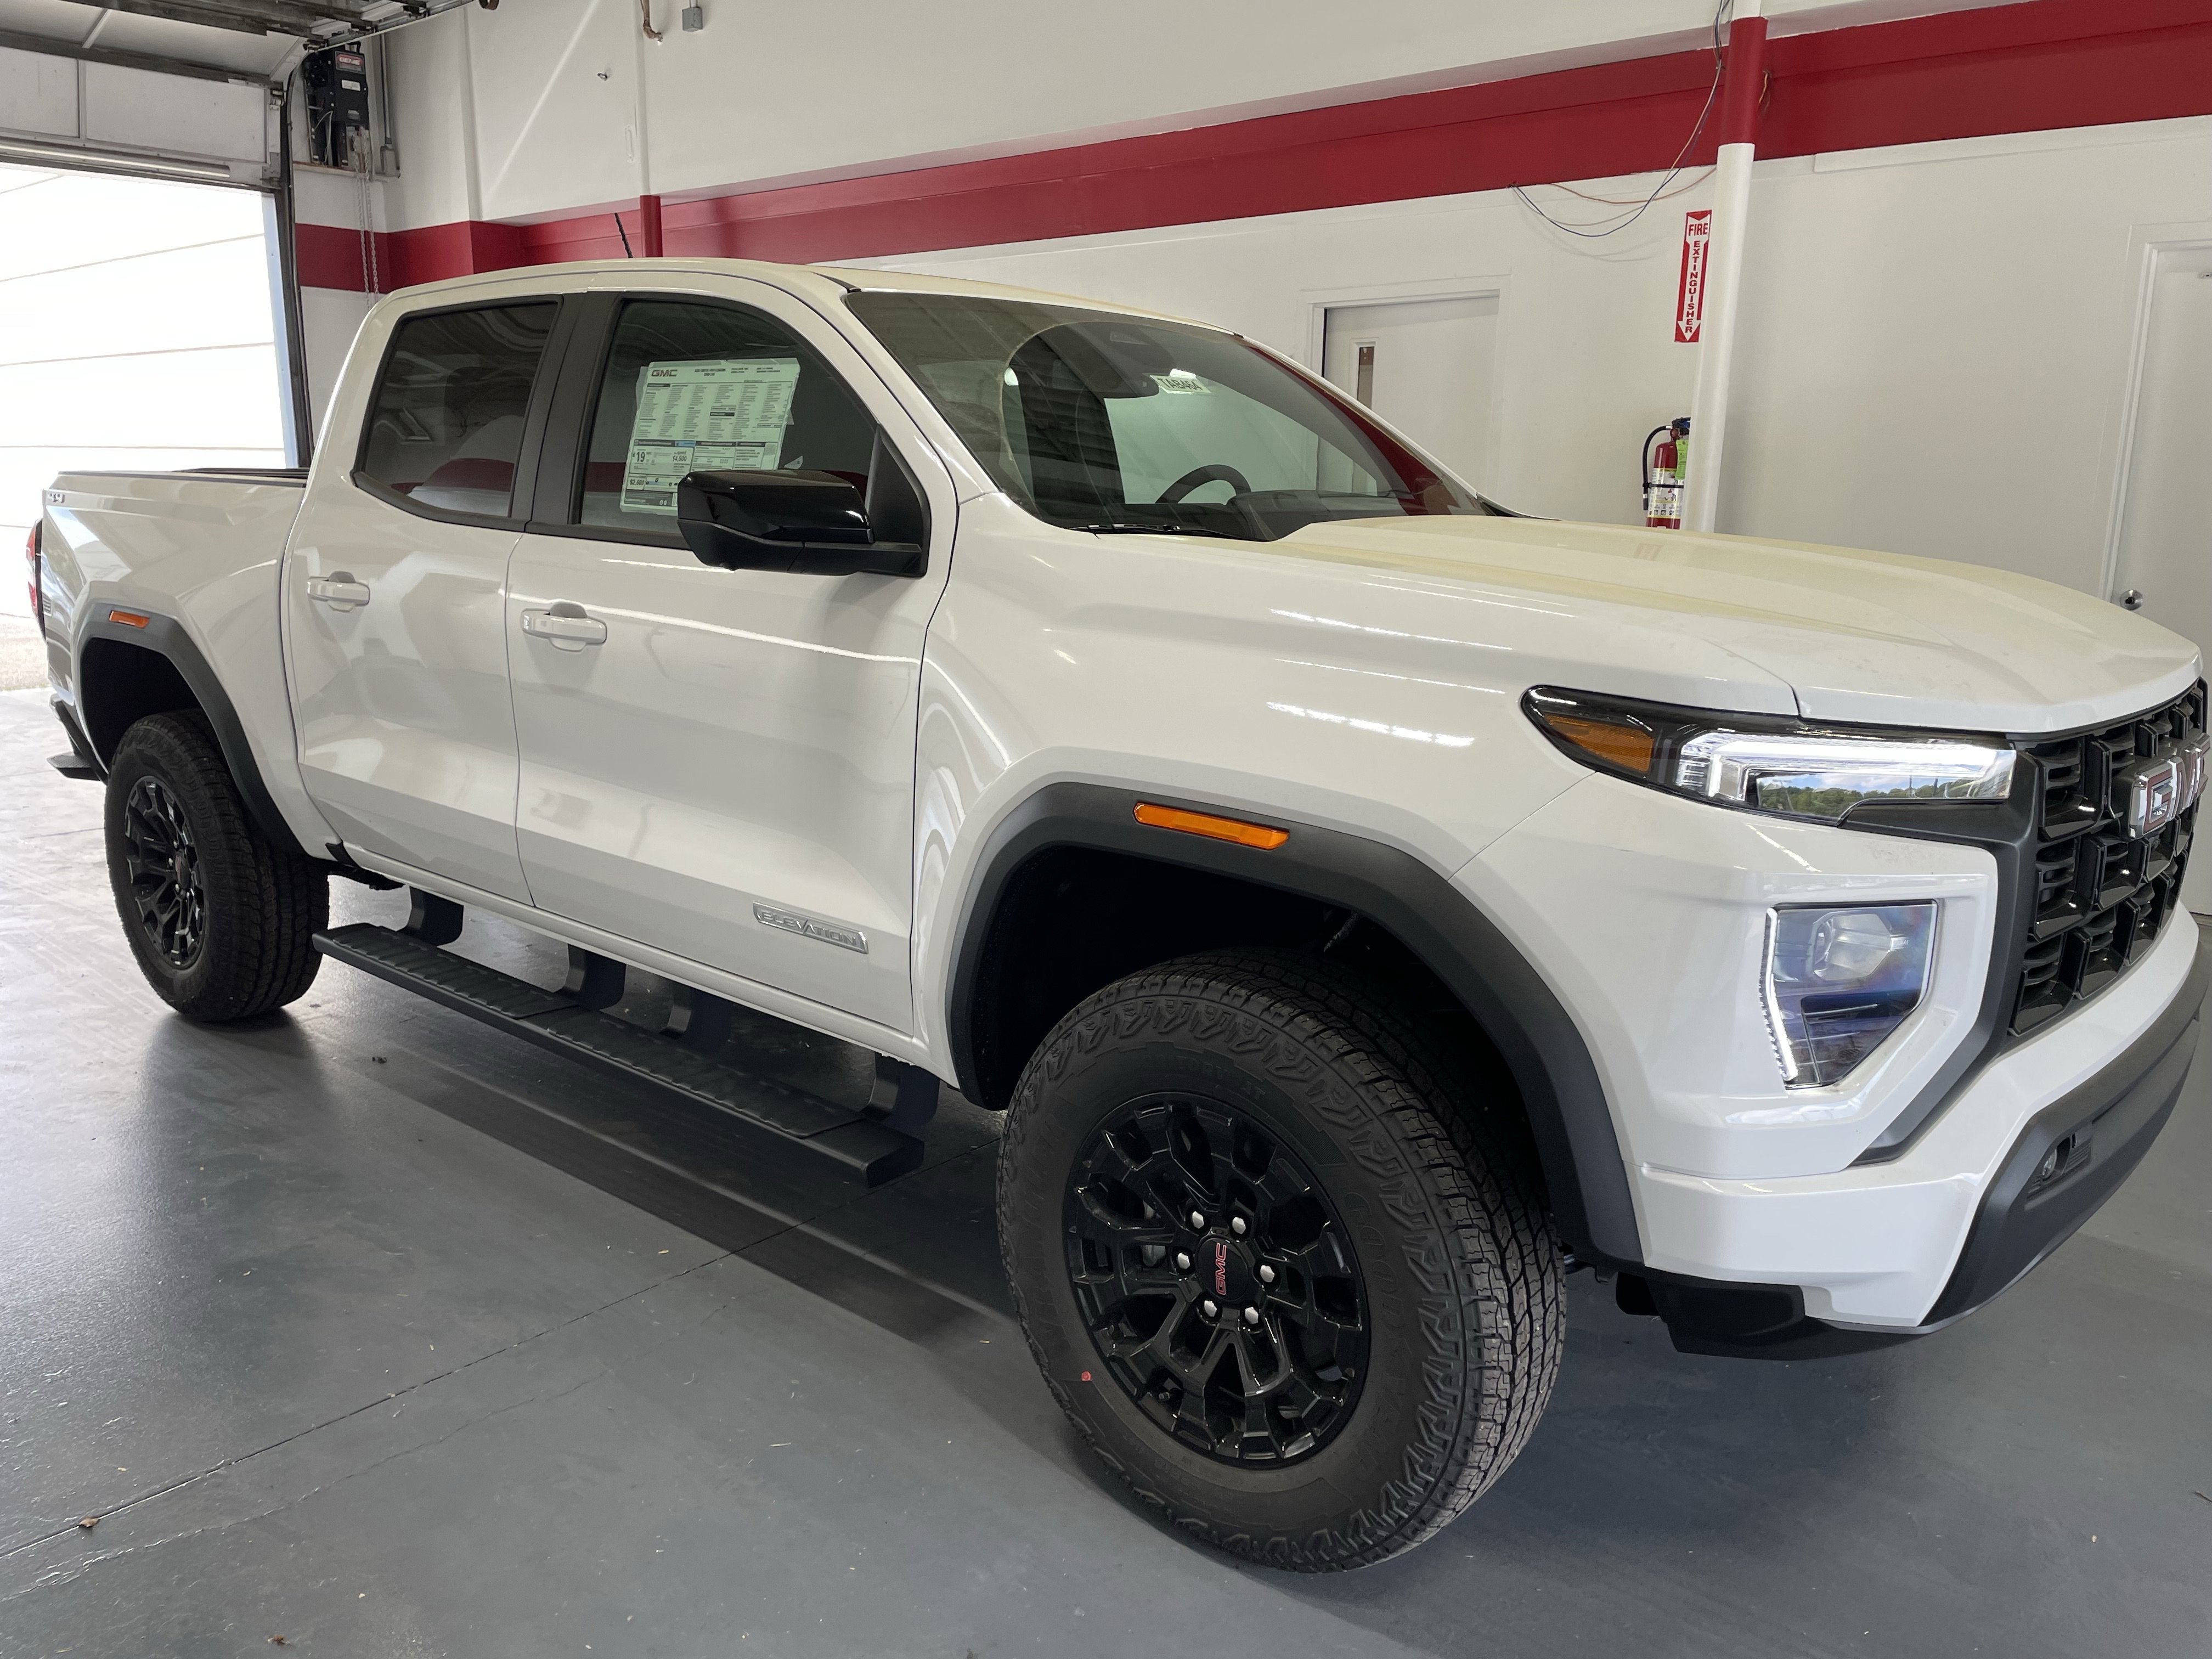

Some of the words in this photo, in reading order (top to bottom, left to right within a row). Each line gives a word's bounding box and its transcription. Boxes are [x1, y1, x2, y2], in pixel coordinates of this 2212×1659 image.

[1688, 223, 1708, 236] FIRE
[1685, 240, 1701, 333] EXTINGUISHER
[636, 452, 645, 462] 19
[2129, 732, 2211, 840] GMC
[761, 910, 856, 945] ELEVATION
[1215, 1243, 1227, 1295] GMC
